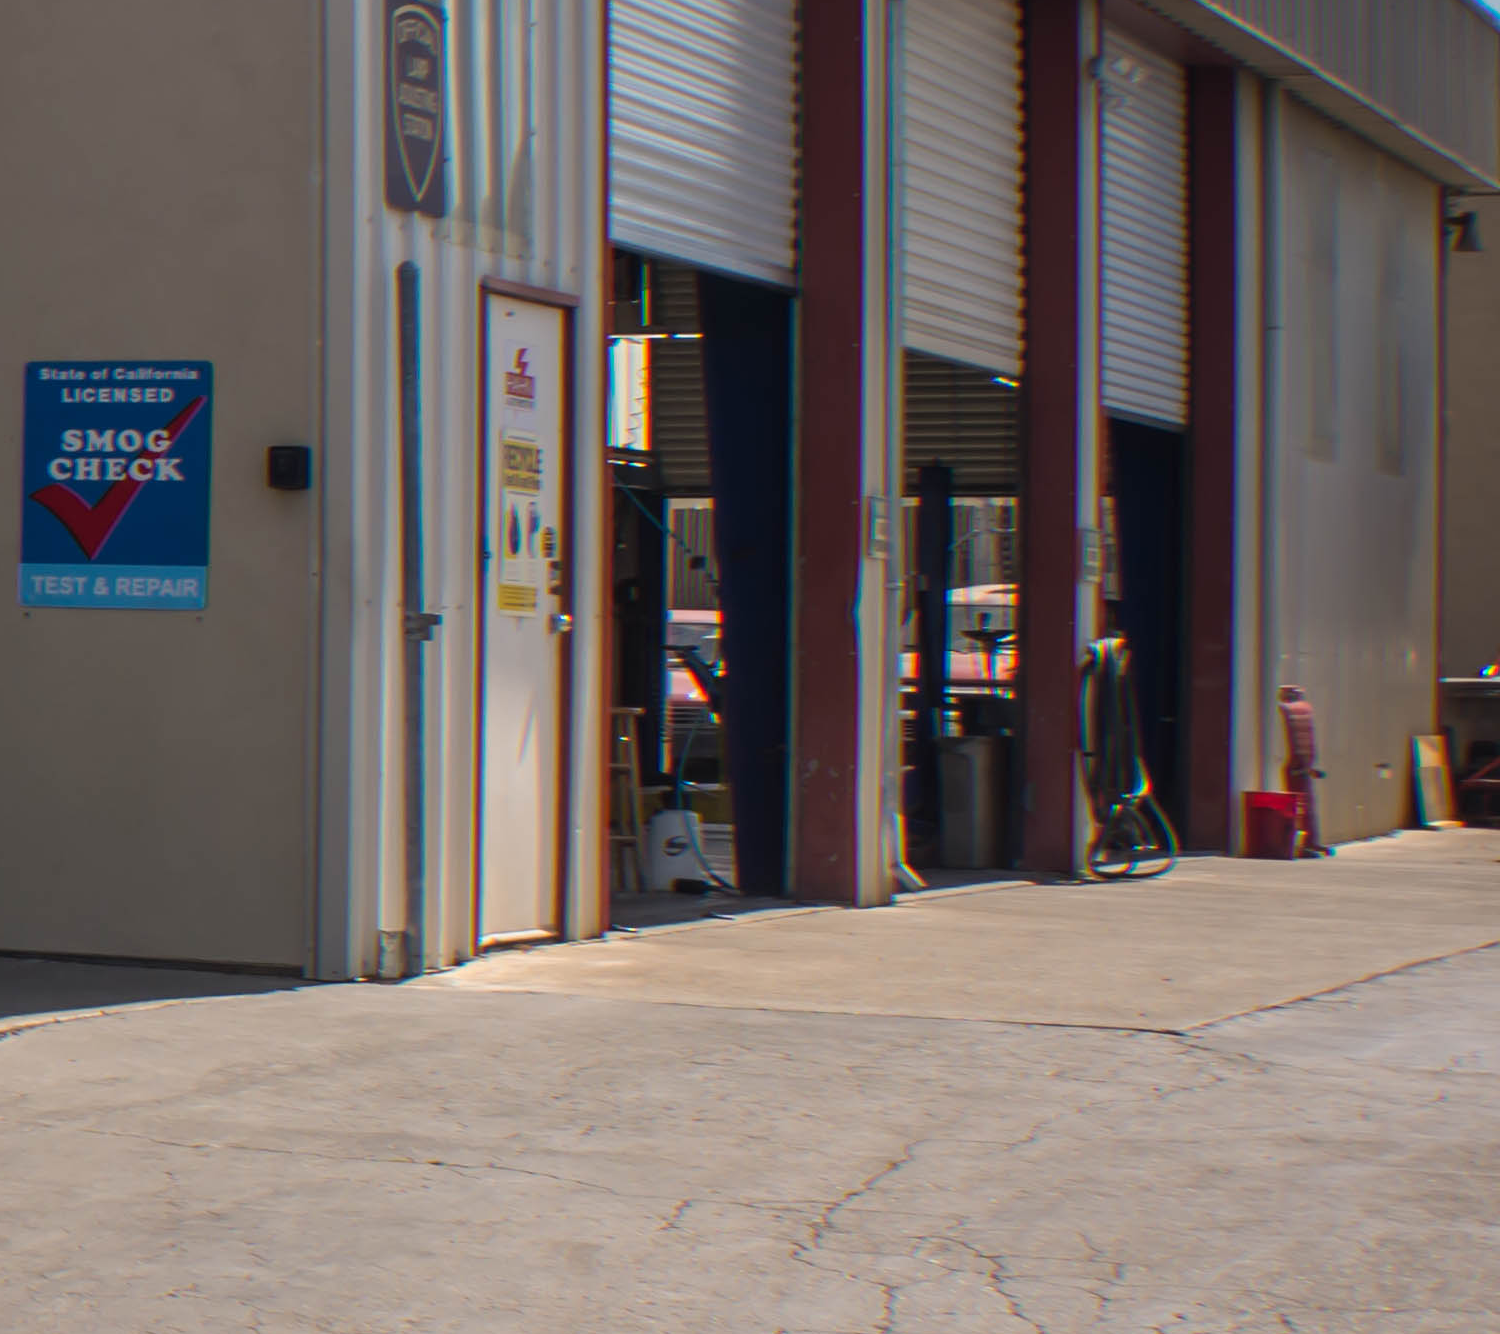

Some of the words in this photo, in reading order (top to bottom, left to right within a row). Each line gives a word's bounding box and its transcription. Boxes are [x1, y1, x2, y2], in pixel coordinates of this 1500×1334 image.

[39, 368, 85, 380] State
[89, 368, 108, 380] of
[112, 368, 199, 380] California
[61, 388, 174, 403] LICENSED
[61, 429, 172, 452] SMOG
[47, 458, 185, 481] CHECK
[31, 576, 87, 595] TEST
[93, 577, 109, 595] &
[115, 577, 199, 597] REPAIR
